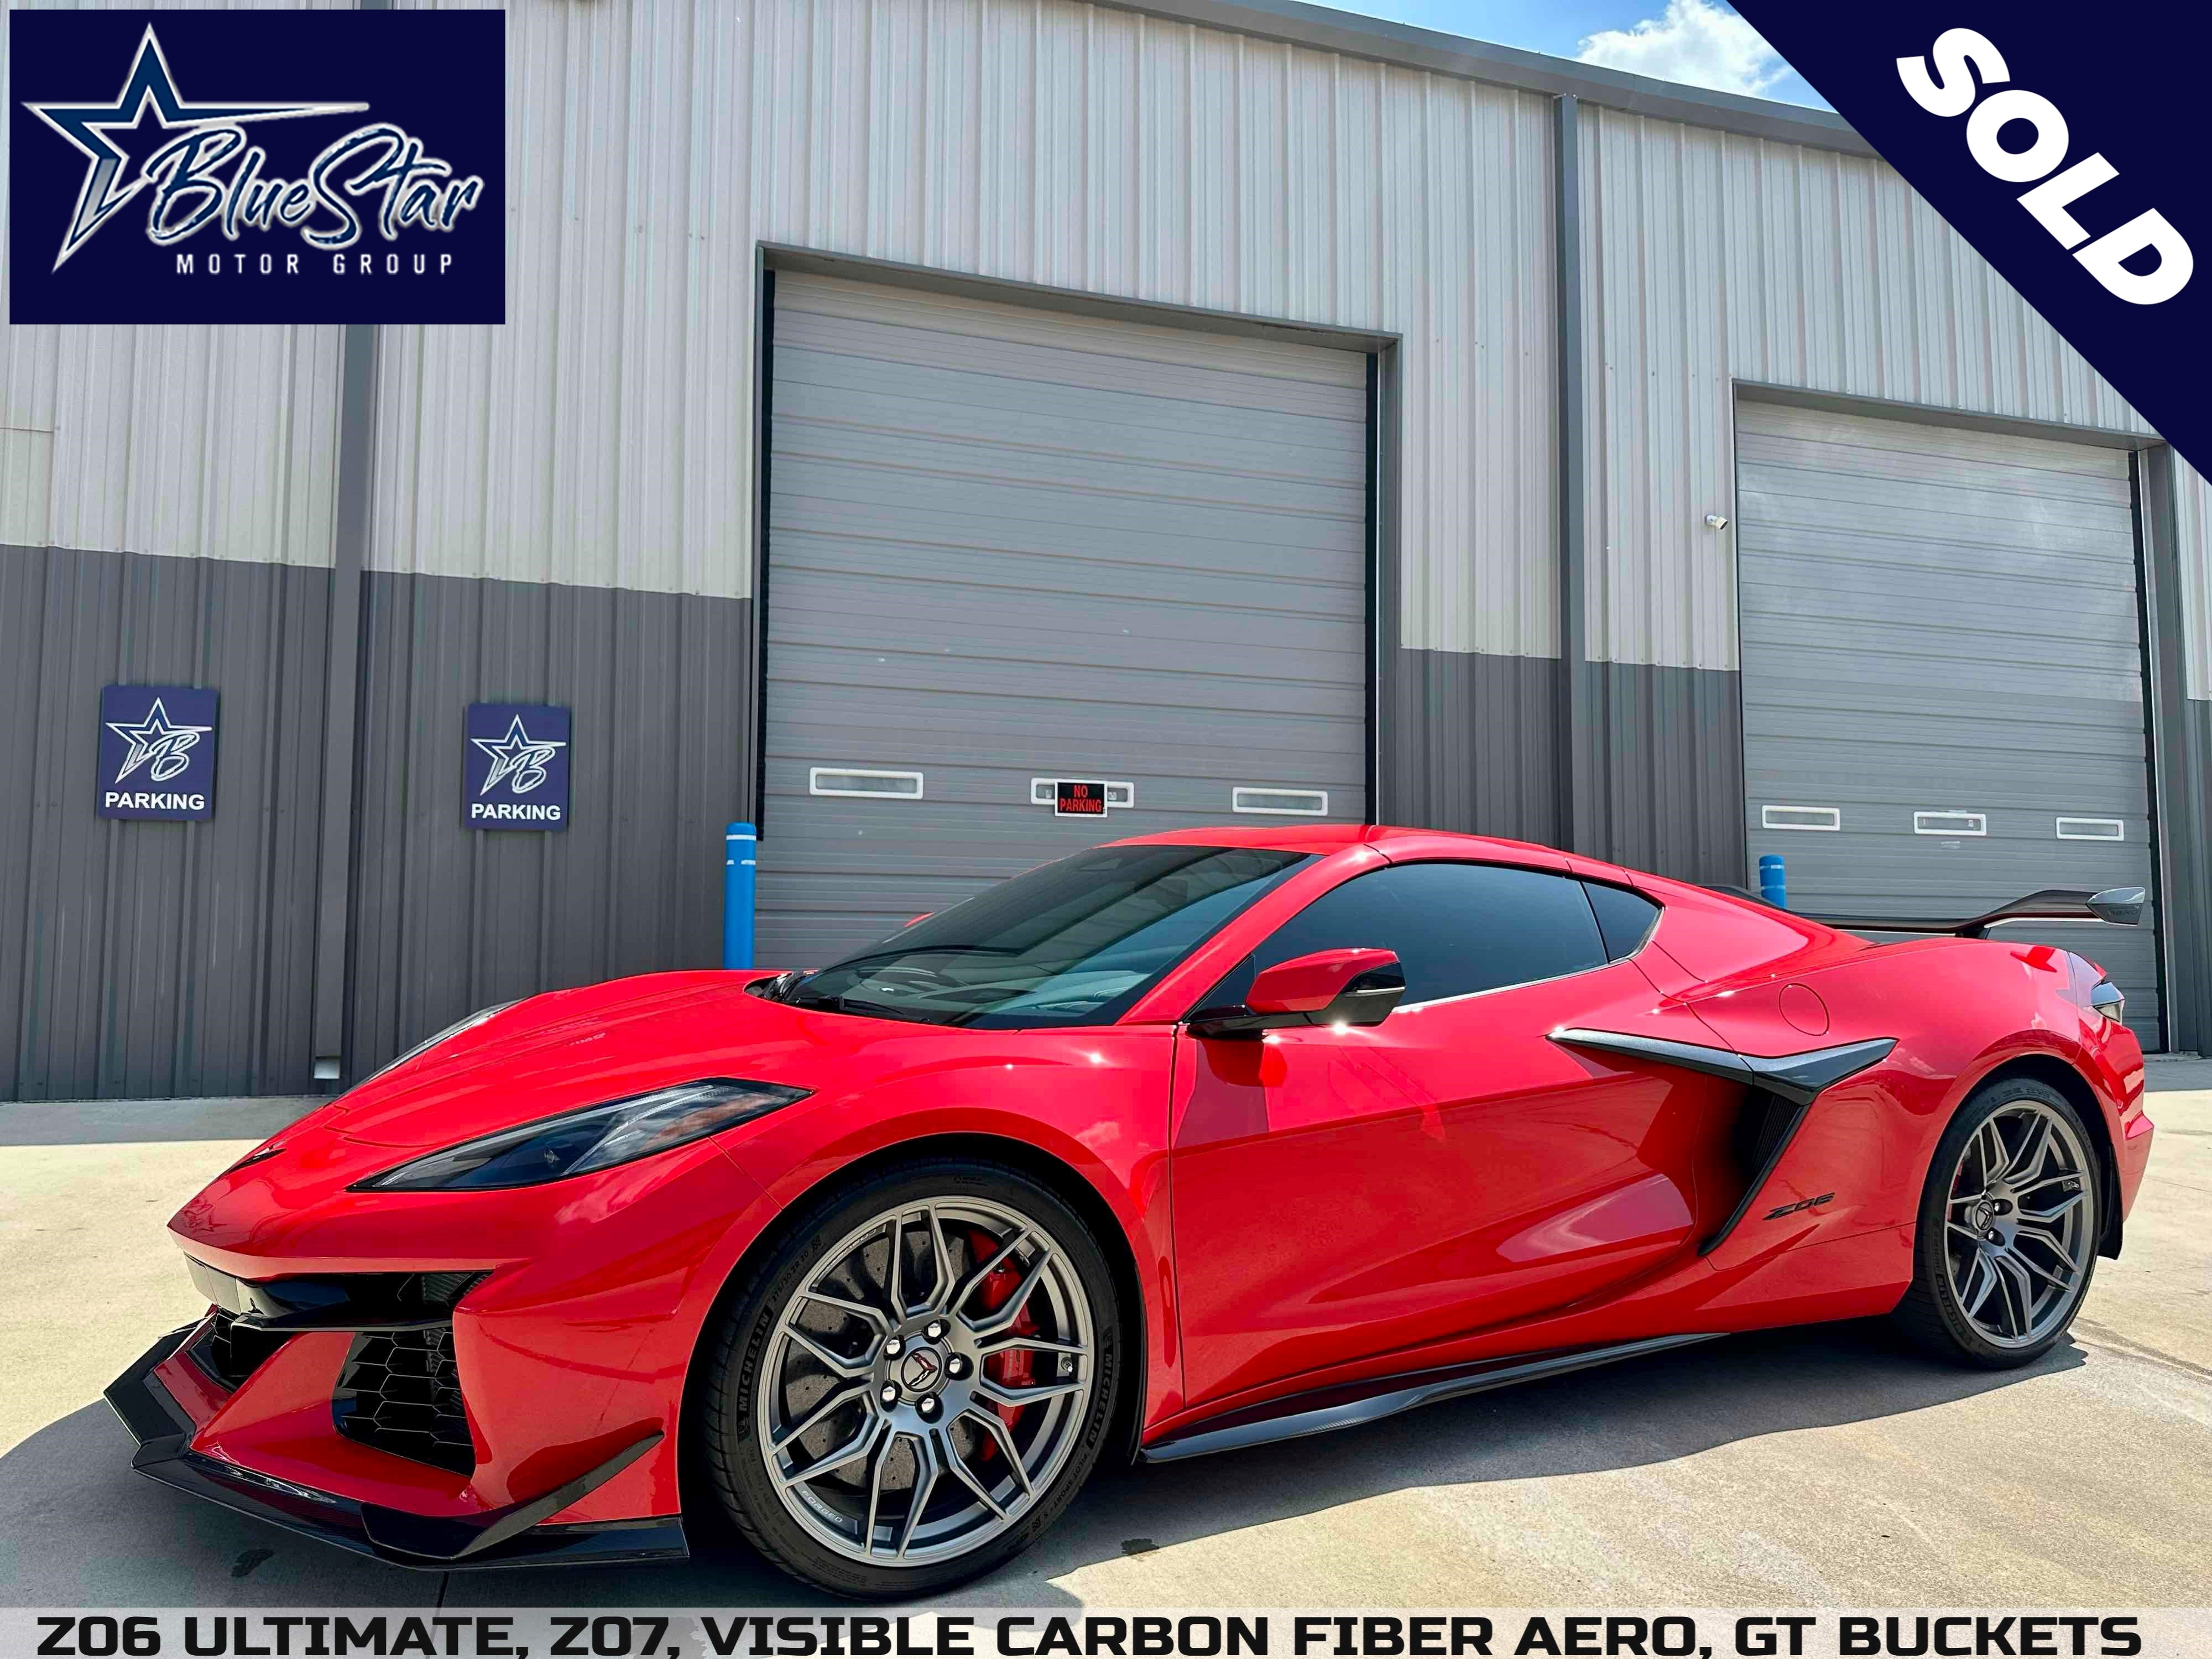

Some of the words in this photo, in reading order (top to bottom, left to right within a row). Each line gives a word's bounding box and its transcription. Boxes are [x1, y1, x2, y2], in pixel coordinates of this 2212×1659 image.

[105, 792, 205, 810] PARKING
[1073, 785, 1088, 798] NO
[471, 804, 561, 821] PARKING
[1060, 798, 1102, 812] PARKING
[1762, 1192, 1835, 1220] Z06
[739, 1311, 770, 1412] MICHELIN
[1087, 1353, 1113, 1443] MICHELIN
[802, 1490, 843, 1522] FORGED
